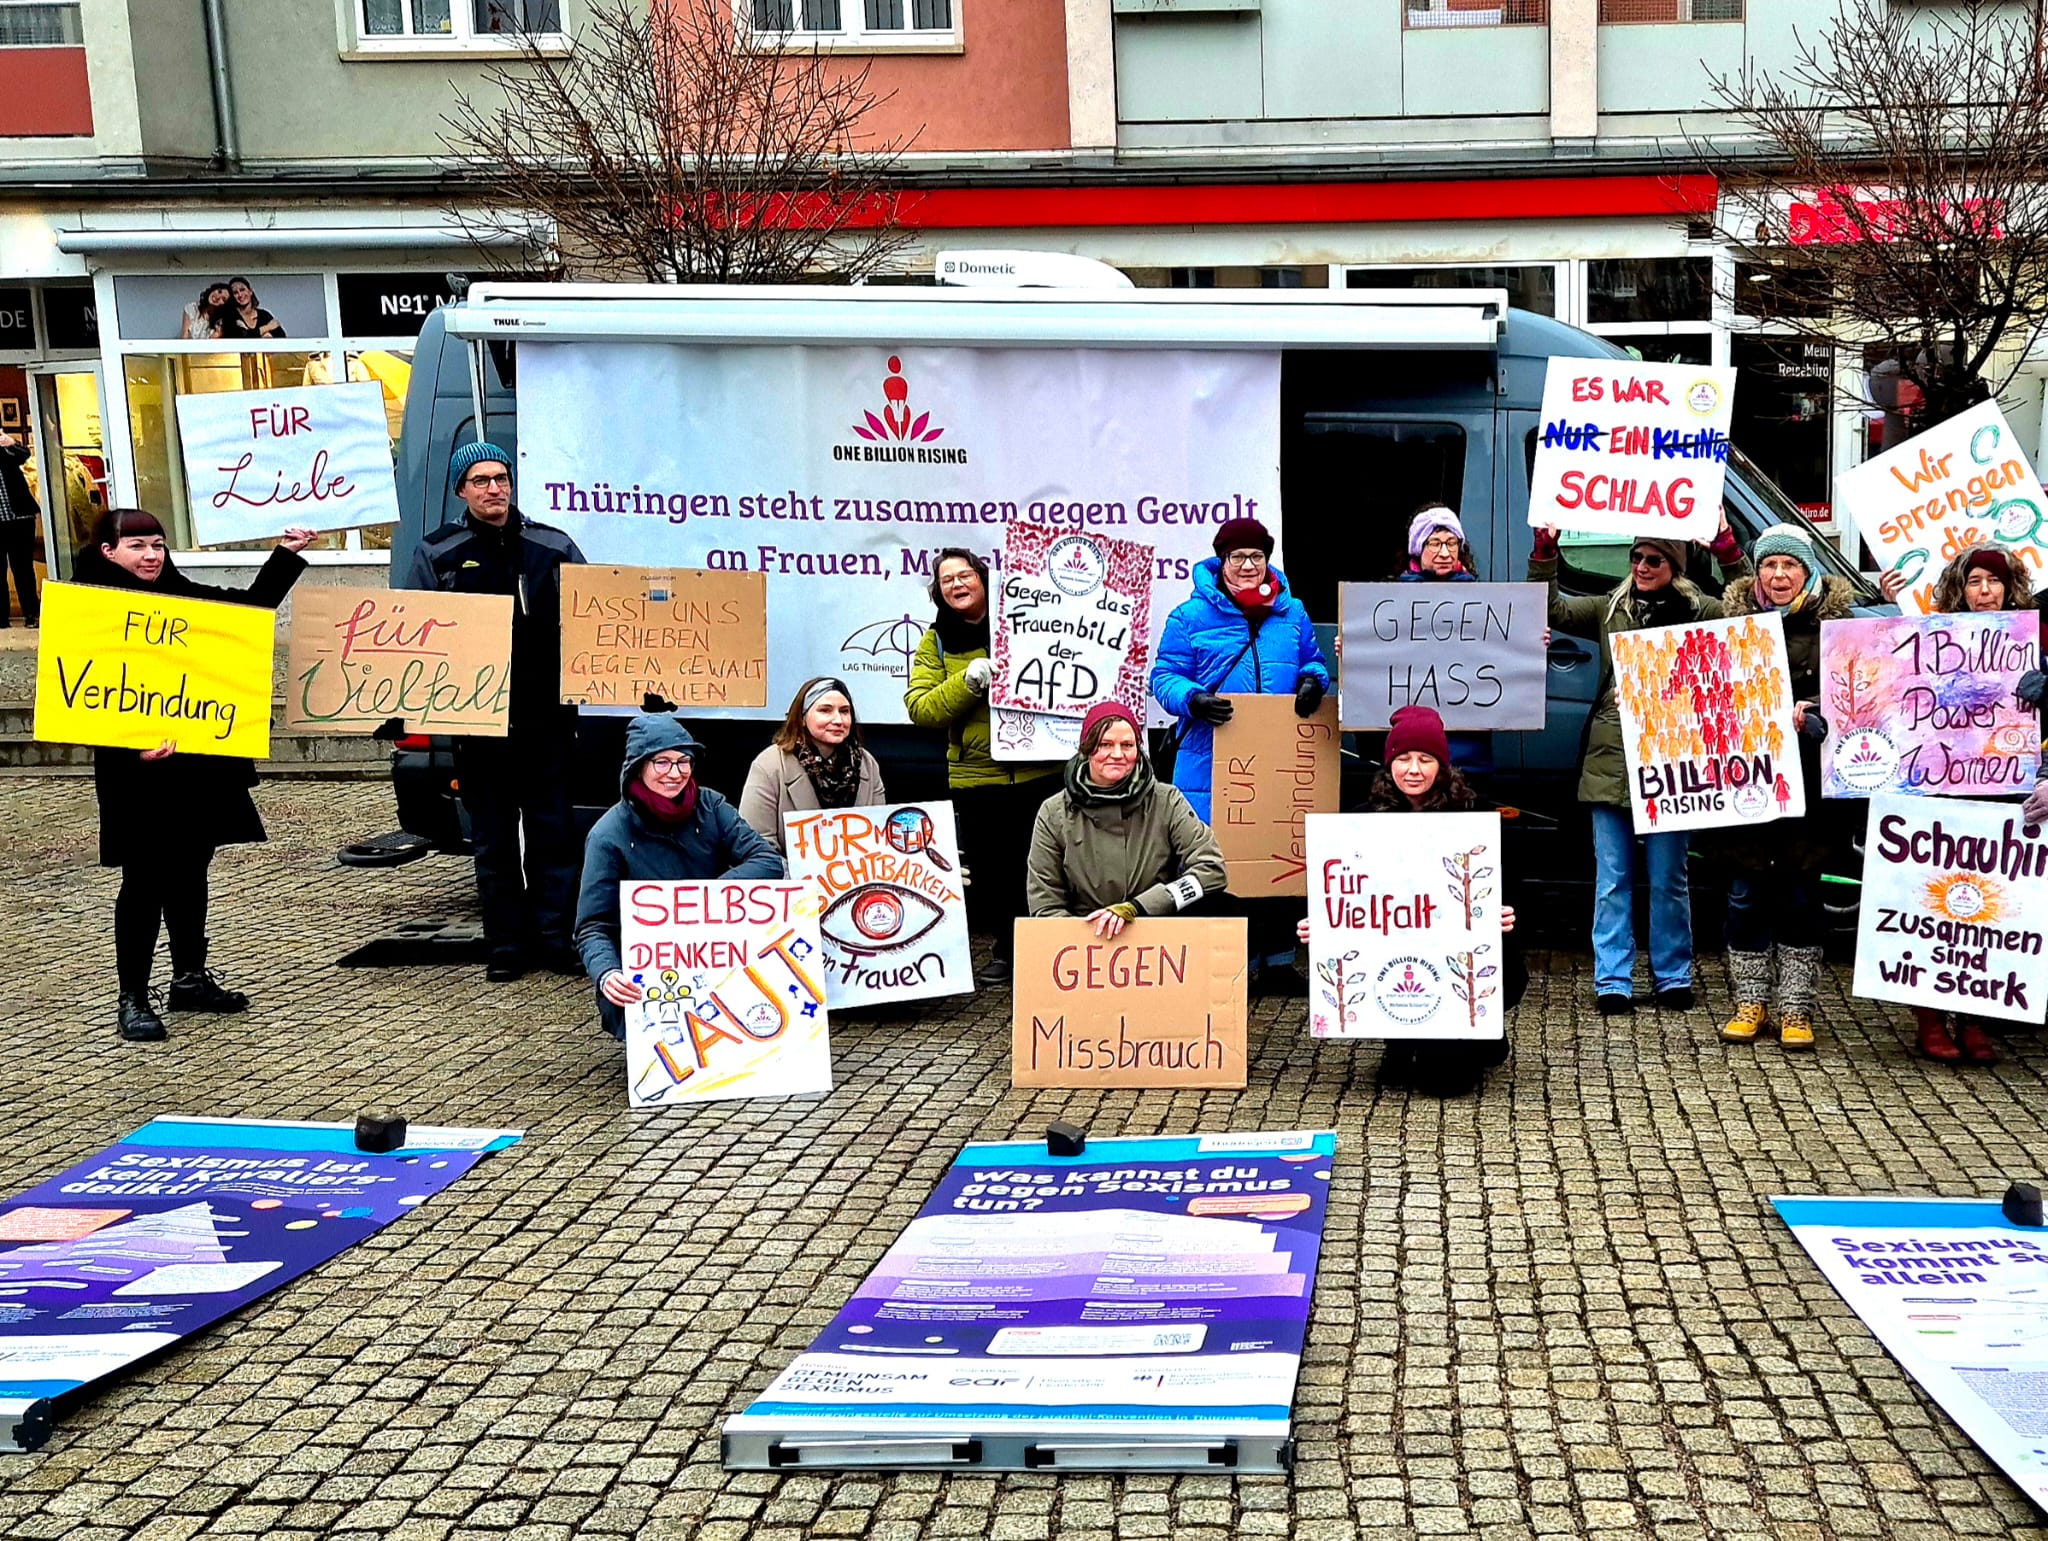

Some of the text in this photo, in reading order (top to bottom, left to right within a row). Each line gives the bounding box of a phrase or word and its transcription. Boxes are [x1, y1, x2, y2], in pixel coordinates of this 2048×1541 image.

[959, 261, 1015, 275] Dometic
[493, 318, 520, 326] THULE
[1804, 343, 1829, 358] Mein
[1572, 376, 1604, 402] ES
[1612, 376, 1670, 406] WAR
[251, 403, 312, 438] FÜR
[1543, 419, 1601, 452] NUR
[1609, 426, 1650, 455] EIN
[833, 445, 968, 464] ONE BILLION RISING
[1889, 448, 1954, 494] Wir
[212, 450, 355, 509] Liebe
[1556, 470, 1695, 519] SCHLAG
[545, 482, 1259, 530] Thüringen steht zusammen gegen Gewalt
[1878, 459, 2025, 544] sprengen
[707, 549, 748, 571] an
[758, 546, 890, 580] Frauen,
[572, 590, 740, 625] LASST UNS
[1005, 576, 1062, 611] Gegen
[1096, 590, 1131, 616] das
[124, 610, 188, 647] FÜR
[335, 599, 457, 661] für
[596, 624, 709, 651] ERHEBEN
[1007, 611, 1126, 651] Frauenbild
[1373, 600, 1512, 642] GEGEN
[571, 651, 766, 680] GEGEN GEWALT
[1047, 640, 1083, 661] der
[1926, 628, 2040, 676] Billion
[842, 663, 904, 674] LAG Thüringer
[1014, 658, 1098, 710] AfD
[1388, 663, 1502, 707] HASS
[57, 656, 236, 740] Verbindung
[298, 659, 510, 727] Vielfalt
[586, 679, 727, 702] AN FRAUEN
[1902, 686, 2005, 731] Power
[1638, 754, 1773, 800] BILLION
[1900, 742, 2026, 787] Women
[1223, 754, 1256, 825] FÜR
[1661, 793, 1725, 815] RISING
[786, 813, 938, 862] FÜR MEHR
[1322, 858, 1369, 895] Für
[631, 885, 804, 926] SELBST
[1325, 894, 1437, 936] Vielfalt
[629, 939, 747, 970] DENKEN
[840, 946, 945, 990] Frauen
[1052, 944, 1187, 991] GEGEN
[1377, 955, 1441, 982] ONE BILLION RISING
[1930, 943, 1988, 973] sind
[1879, 951, 2029, 1010] wir stark
[653, 928, 826, 1085] LAUT
[1032, 1013, 1223, 1071] Missbrauch
[85, 1167, 397, 1187] kein Kavaliers-
[110, 1153, 370, 1173] Sexismus ist
[972, 1166, 1259, 1185] Was kannst du
[59, 1179, 207, 1196] delikt!
[952, 1196, 1044, 1211] tun?
[960, 1178, 1291, 1199] gegen Sexismus
[1831, 1238, 2042, 1253] Sexismus
[1843, 1252, 2001, 1269] kommt
[1860, 1270, 1988, 1285] allein
[779, 1384, 894, 1394] SEXISMUS
[787, 1376, 864, 1386] GEGEN
[793, 1369, 929, 1381] GEMEINSAM
